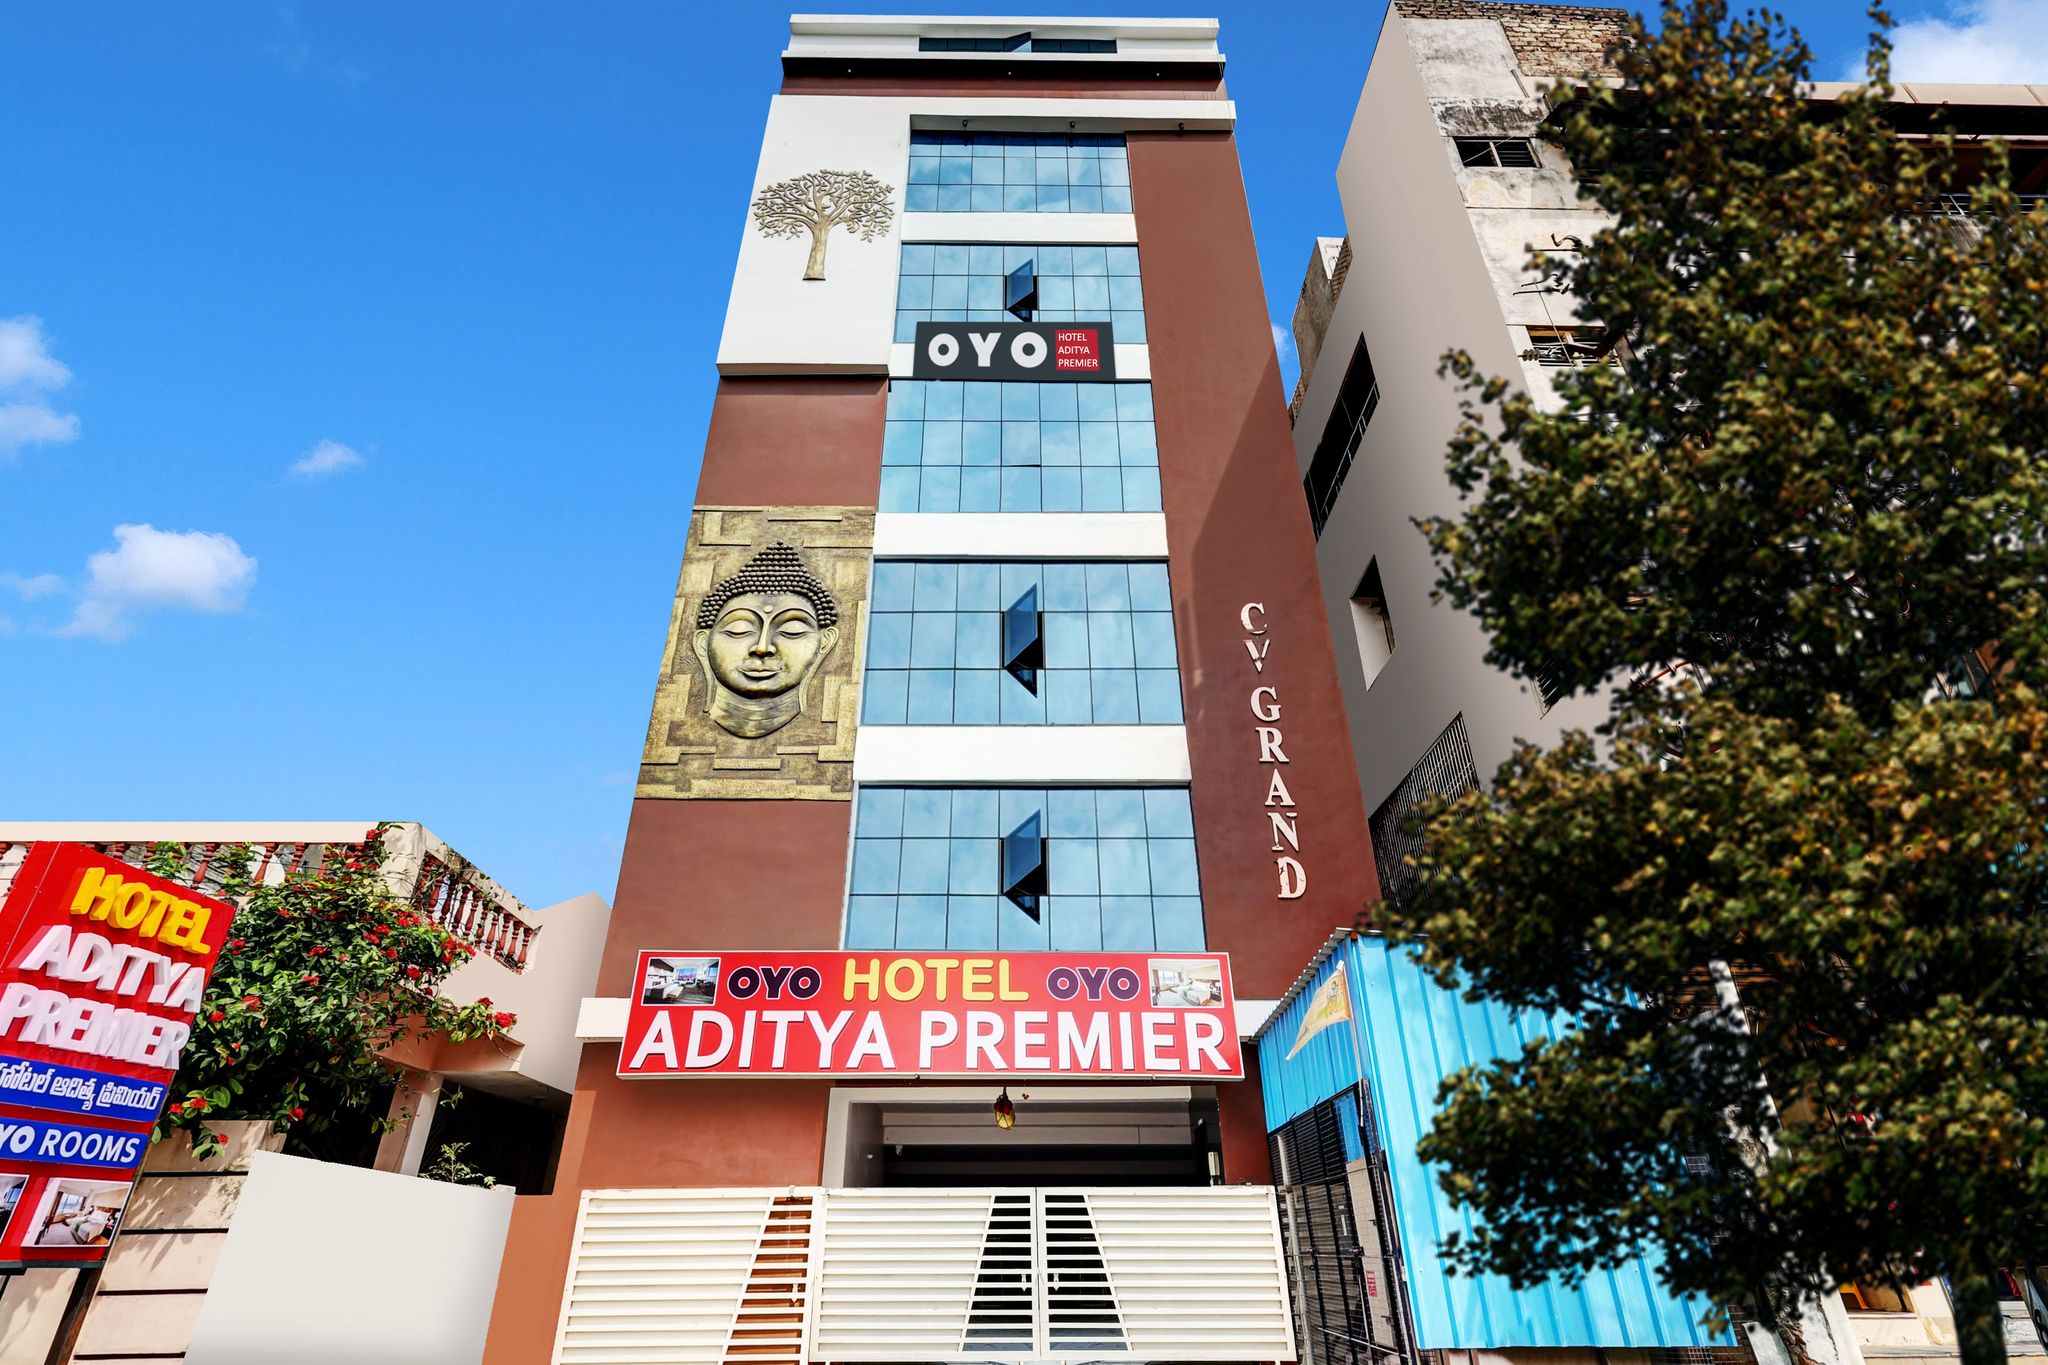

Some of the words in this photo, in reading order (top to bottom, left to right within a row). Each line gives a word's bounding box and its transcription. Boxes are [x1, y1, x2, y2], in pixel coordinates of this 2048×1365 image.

[928, 331, 1048, 368] OYO
[1058, 333, 1087, 342] HOTEL
[1058, 346, 1090, 355] ADITYA
[1058, 358, 1098, 368] PREMIER
[1250, 686, 1307, 899] GRAND
[69, 867, 212, 955] HOTEL
[18, 924, 206, 1013] ADITYA
[727, 965, 822, 1001] OYO
[843, 958, 1030, 1002] HOTEL
[1046, 966, 1140, 1001] OYO
[0, 982, 191, 1071] PREMIER
[628, 1009, 898, 1070] ADITYA
[918, 1010, 1231, 1072] PREMIER
[38, 1128, 140, 1164] ROOMS
